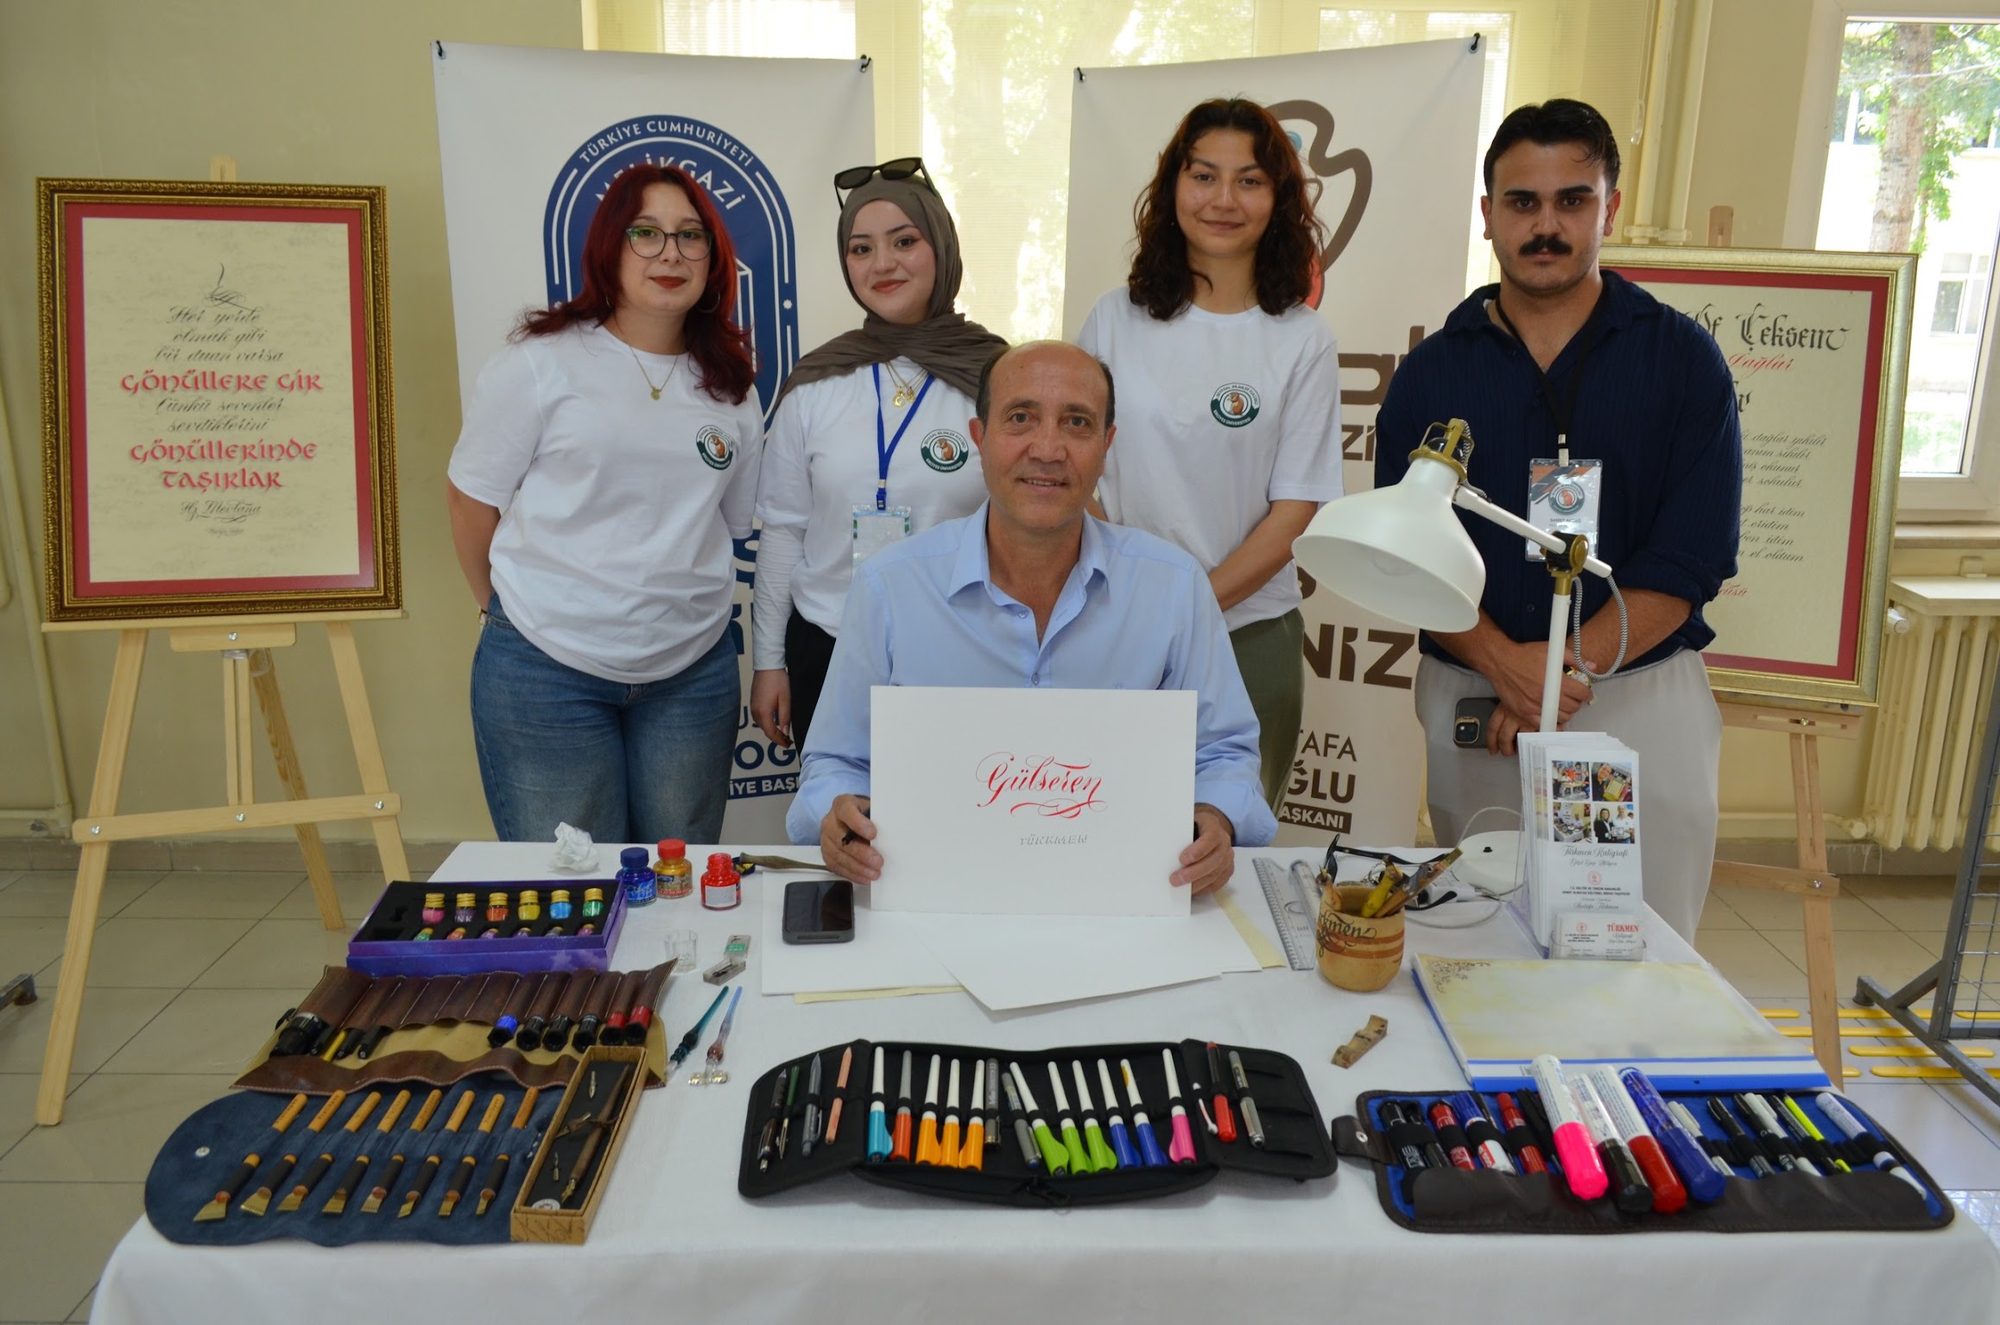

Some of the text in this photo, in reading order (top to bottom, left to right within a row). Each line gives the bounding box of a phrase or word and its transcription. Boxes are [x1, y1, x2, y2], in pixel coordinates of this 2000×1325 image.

[579, 120, 755, 167] TÜRKİYE CUMHURİYETİ
[1300, 729, 1357, 762] AFA
[761, 776, 799, 794] BAŞ
